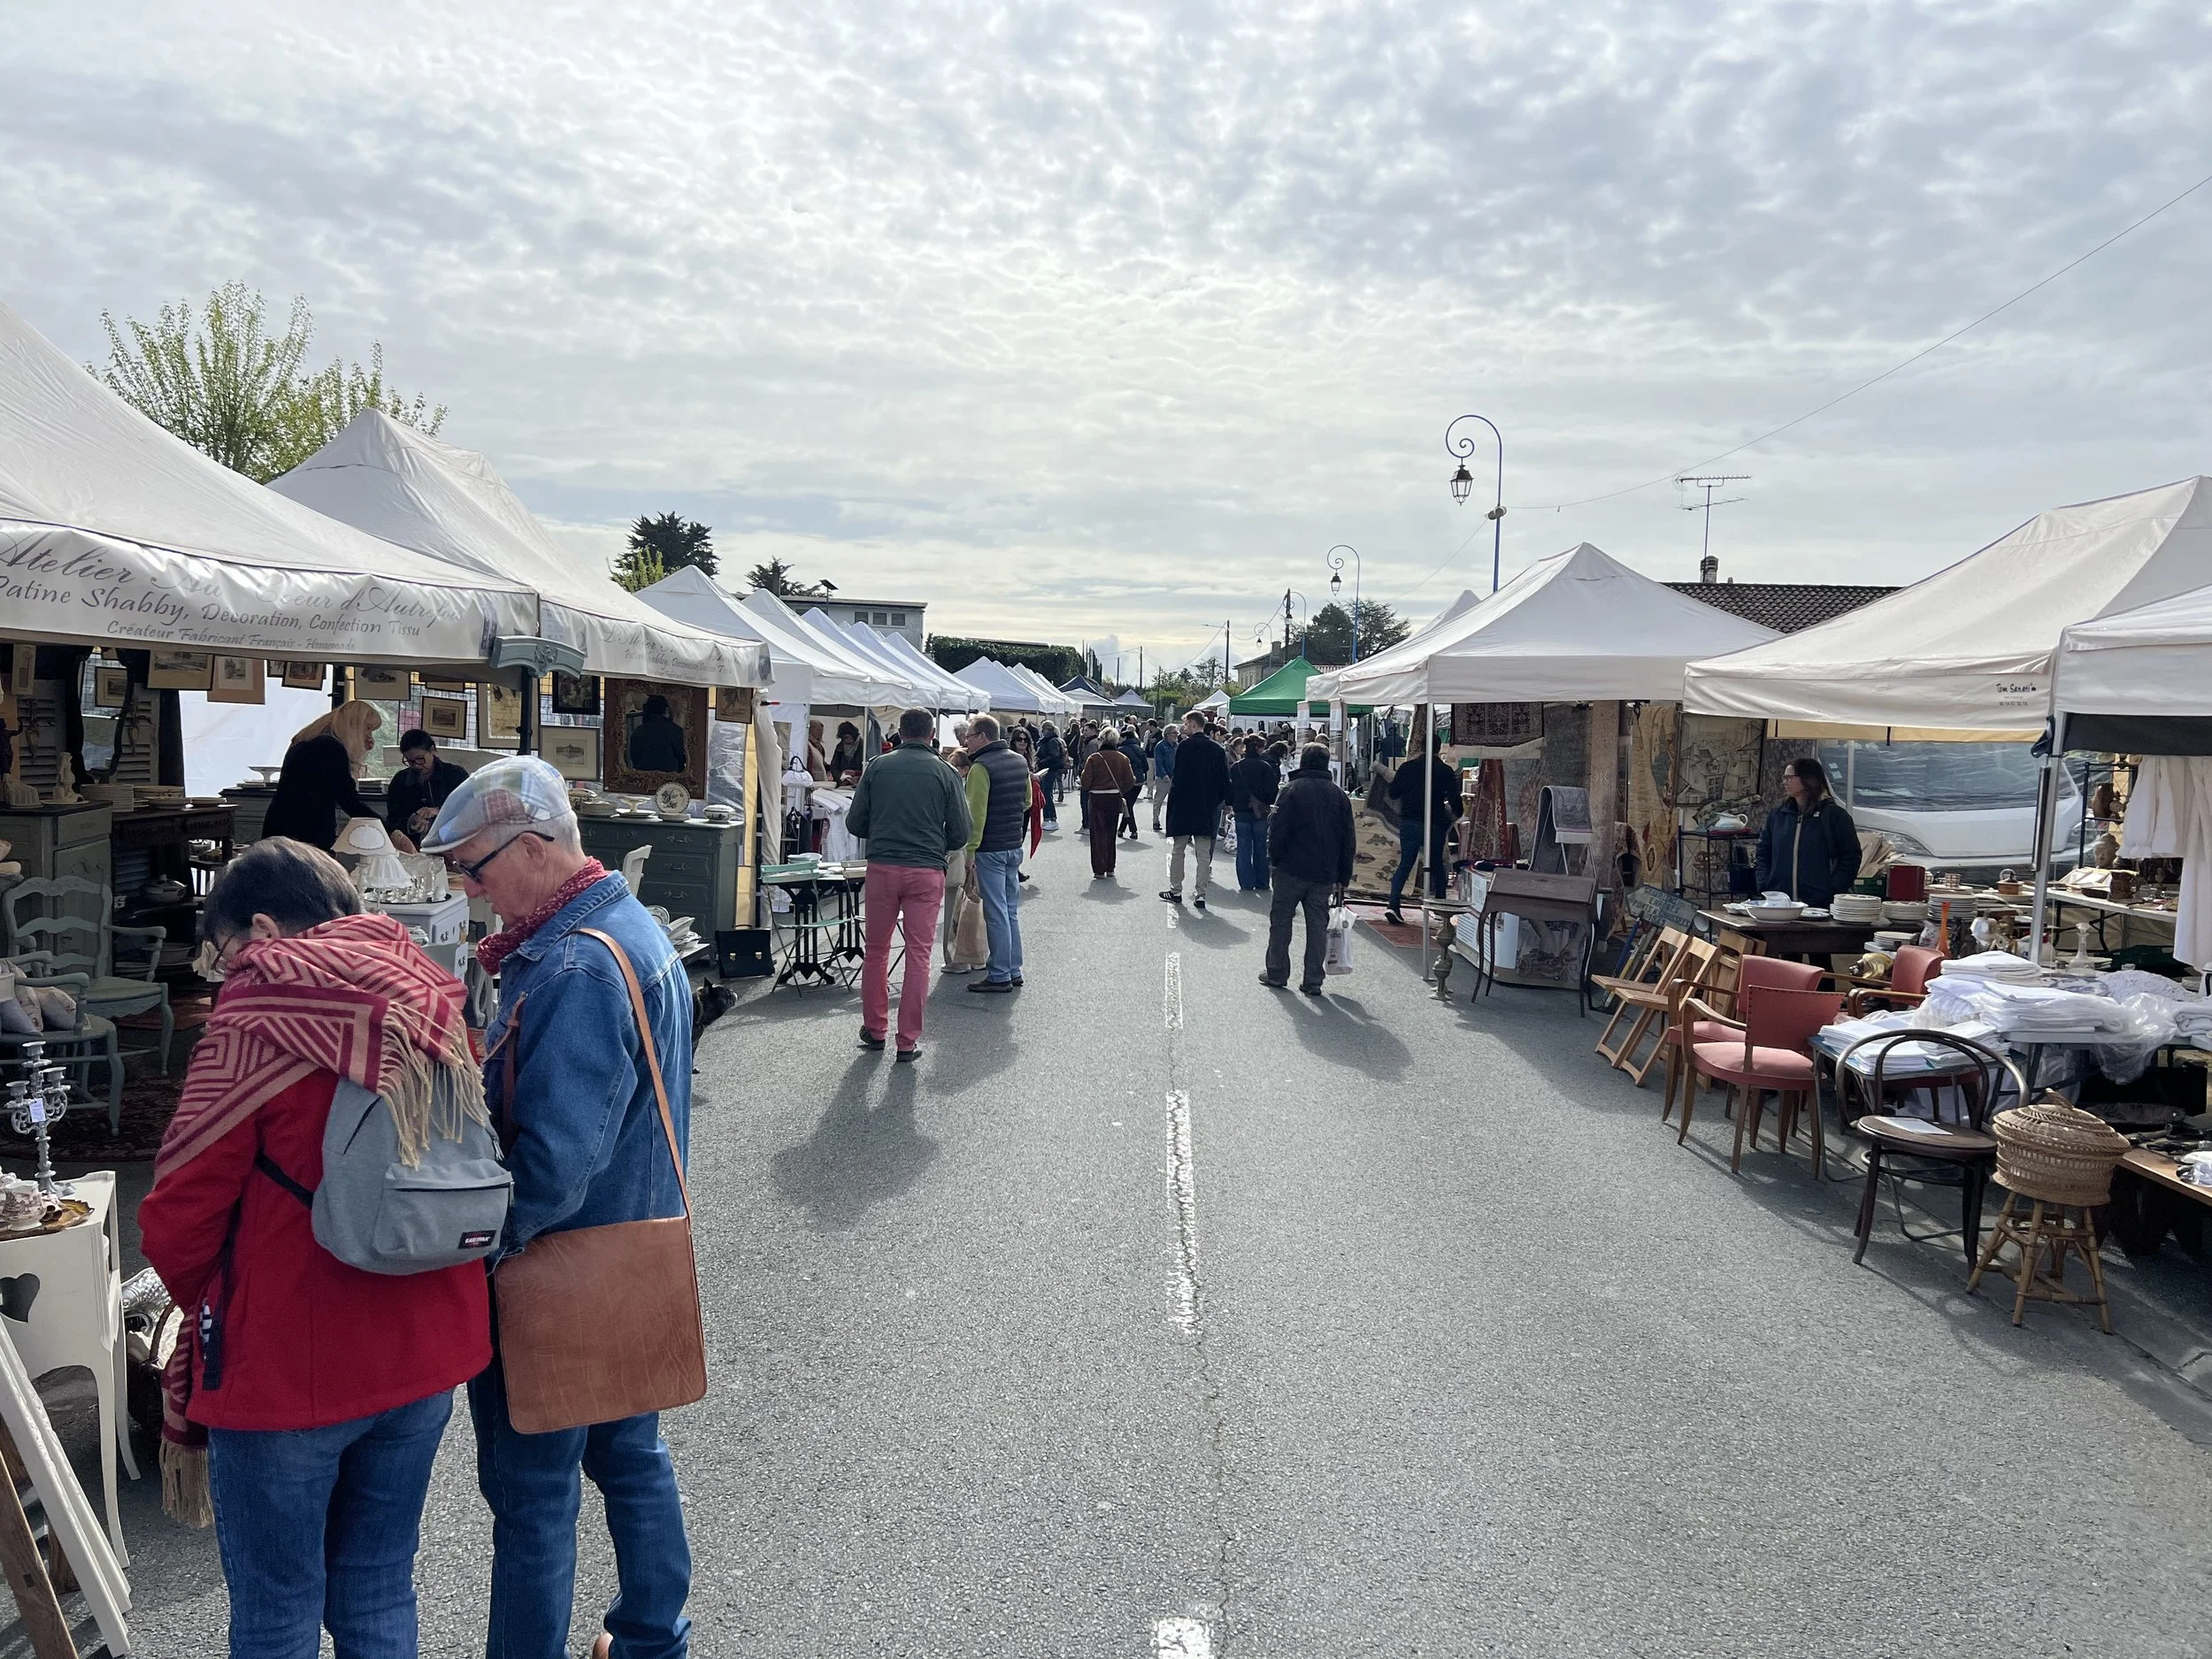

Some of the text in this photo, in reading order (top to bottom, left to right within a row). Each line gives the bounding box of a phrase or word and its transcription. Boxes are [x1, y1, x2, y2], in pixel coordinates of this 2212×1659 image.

[81, 587, 189, 626] Shabby,
[310, 613, 381, 636] Confection
[389, 619, 420, 636] Tissu
[107, 620, 175, 639] Créateur
